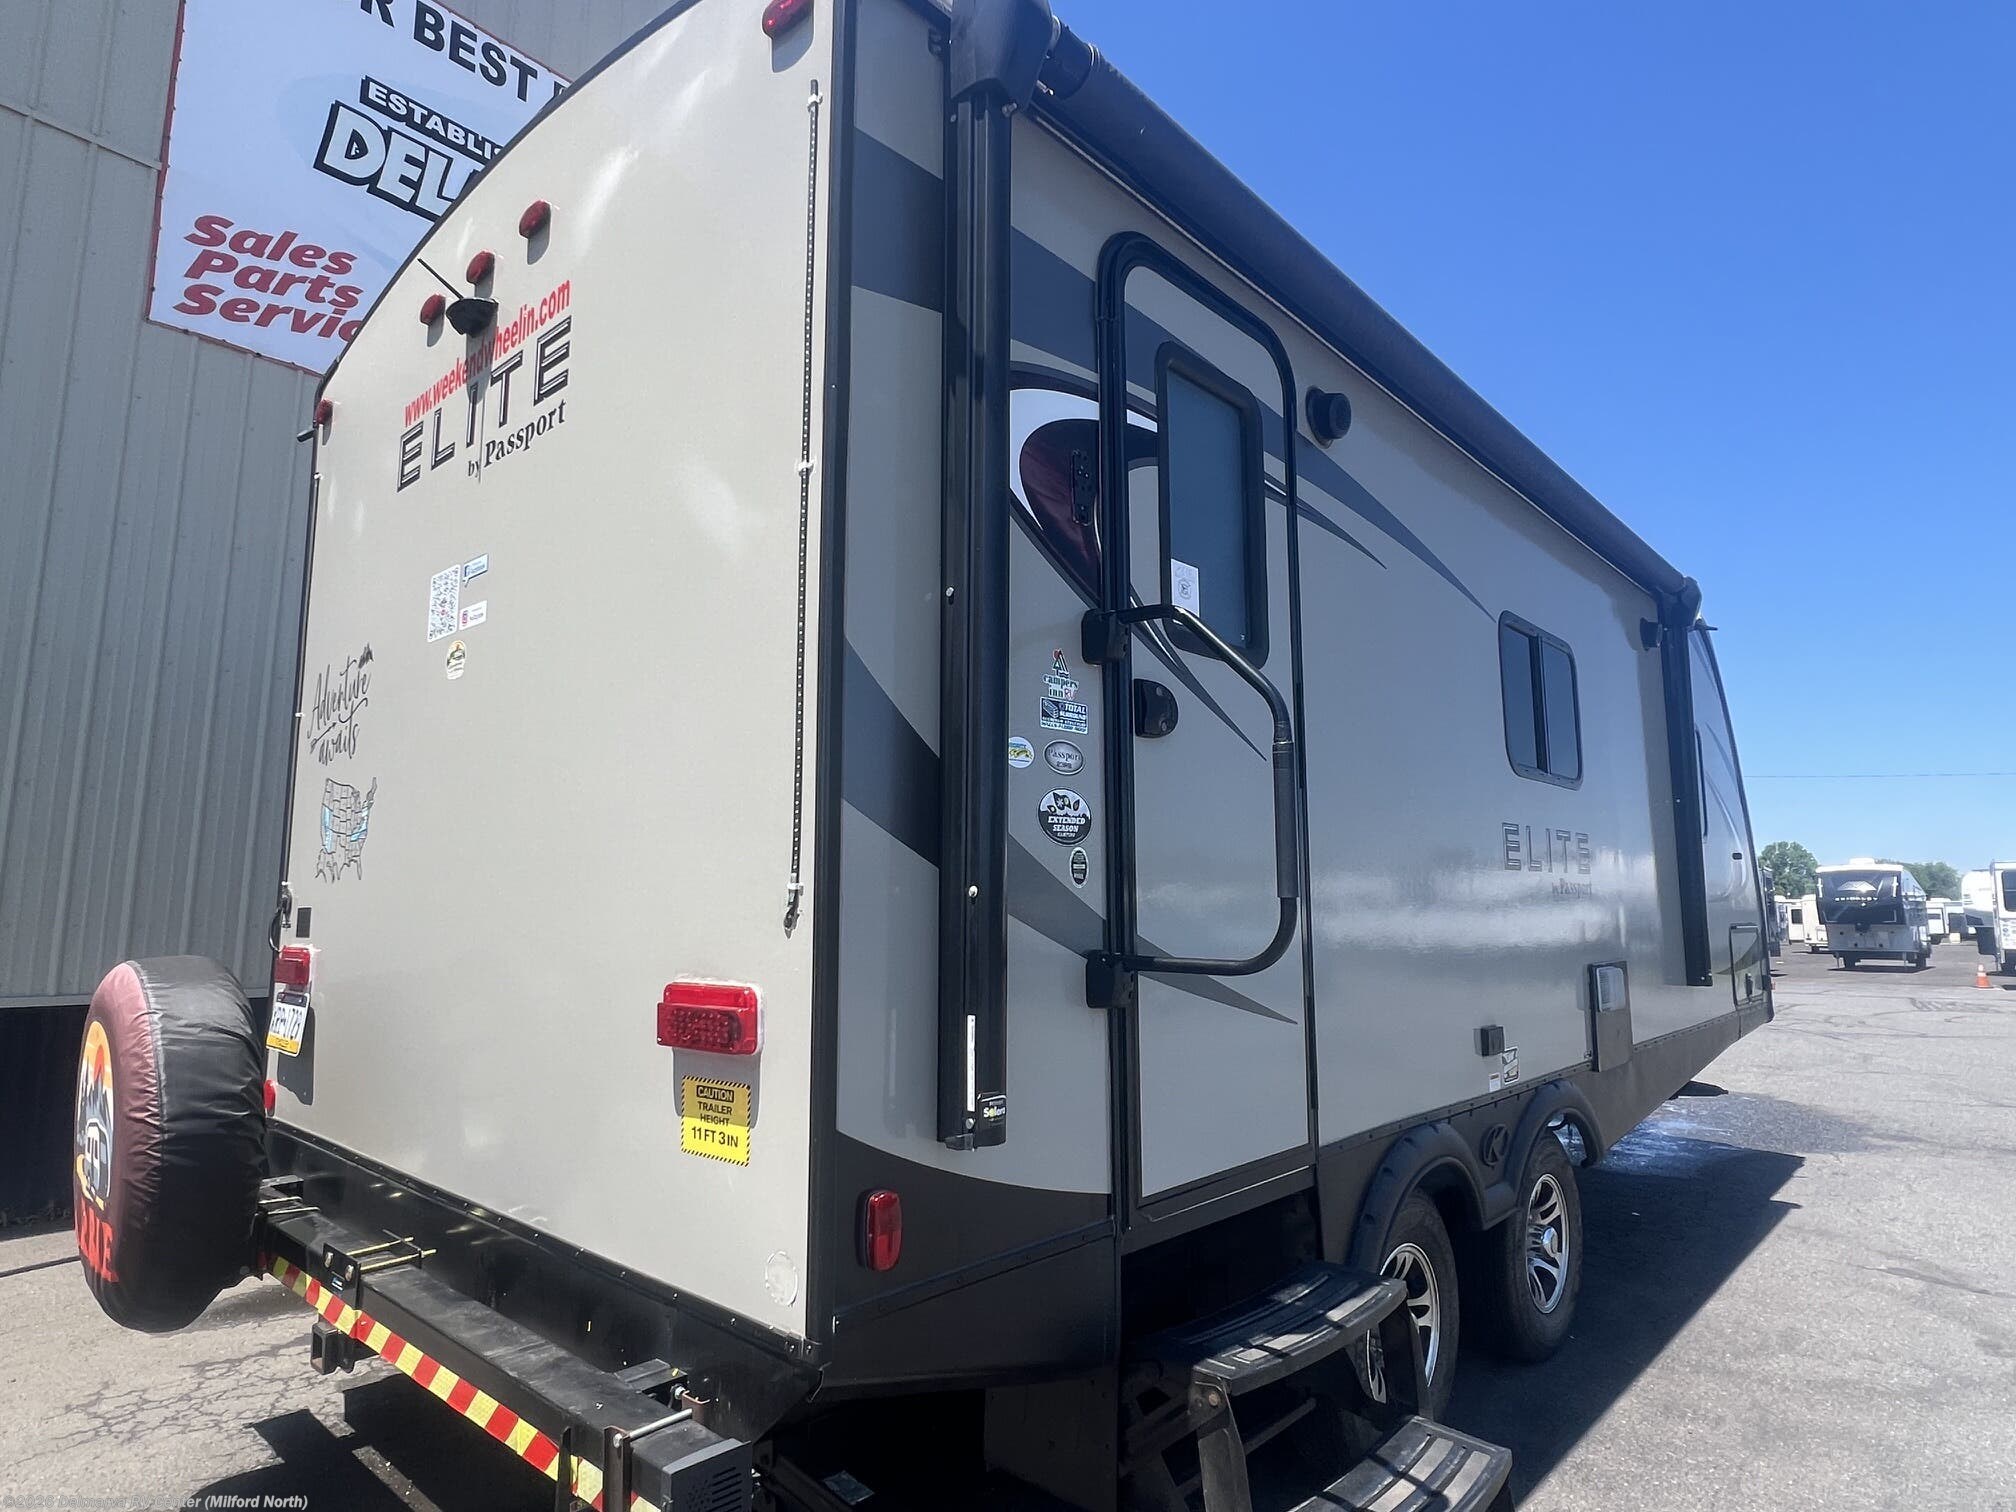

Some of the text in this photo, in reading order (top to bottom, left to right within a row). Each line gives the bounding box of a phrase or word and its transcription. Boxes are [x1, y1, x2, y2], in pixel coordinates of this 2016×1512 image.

[413, 0, 538, 103] BEST
[184, 215, 357, 275] Sales
[184, 249, 364, 309] Parts
[404, 279, 571, 427] www.weekendwheelin.com
[397, 315, 571, 493] ELITE
[467, 398, 567, 477] by Passport
[307, 655, 371, 740] Adventure
[1065, 703, 1086, 713] TOTAL
[1048, 815, 1085, 825] EXTENDED
[1053, 824, 1079, 833] SEASON
[1501, 822, 1591, 875] ELITE
[1560, 878, 1592, 899] Passport
[697, 1086, 733, 1101] CAUTION
[698, 1101, 732, 1115] TRAILER
[691, 1126, 739, 1148] 11 FT 3 IN
[700, 1113, 730, 1126] HEIGHT
